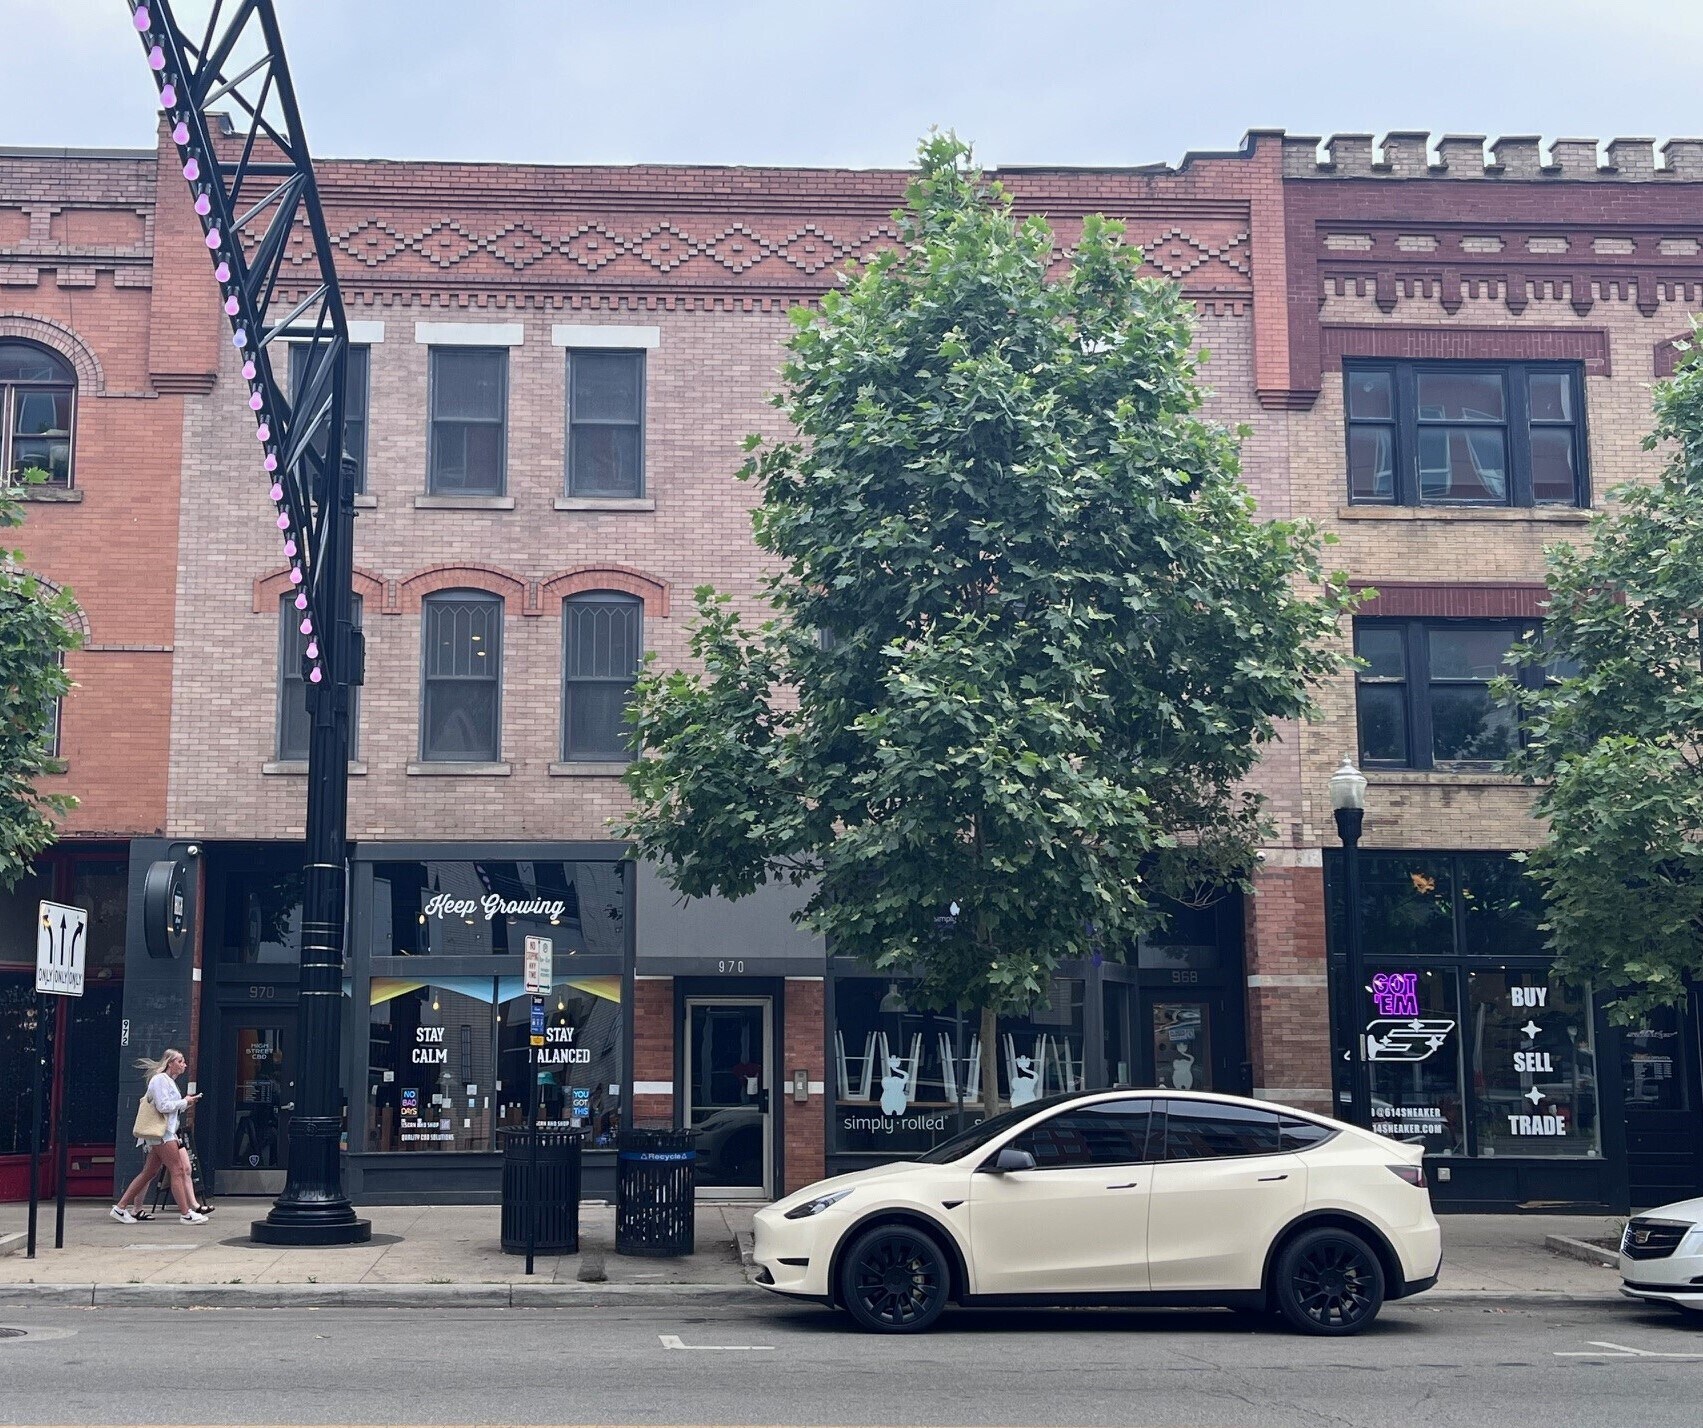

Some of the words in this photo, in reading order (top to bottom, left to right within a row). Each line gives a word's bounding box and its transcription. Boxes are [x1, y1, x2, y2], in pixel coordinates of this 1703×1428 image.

[424, 893, 478, 919] Keep
[480, 893, 566, 921] Growing
[718, 960, 744, 973] 970
[38, 967, 53, 983] ONLY
[54, 970, 68, 985] ONLY
[69, 971, 82, 987] ONLY
[1172, 971, 1198, 983] 968
[1373, 973, 1417, 995] GOT
[249, 986, 275, 999] 970
[1510, 987, 1547, 1007] BUY
[1374, 994, 1419, 1015] 'EM
[121, 1020, 130, 1046] 972
[416, 1027, 445, 1042] STAY
[545, 1027, 574, 1042] STAY
[411, 1048, 448, 1064] CALM
[1513, 1052, 1553, 1072] SELL
[403, 1090, 416, 1098] NO
[573, 1090, 590, 1099] YOU
[402, 1099, 417, 1107] BAD
[572, 1099, 589, 1107] GOT
[400, 1107, 418, 1115] DAYS
[573, 1107, 589, 1116] THIS
[1371, 1124, 1443, 1135] 14SNEAKER.COM
[1508, 1115, 1567, 1136] TRADE
[648, 1152, 681, 1162] Recycle
